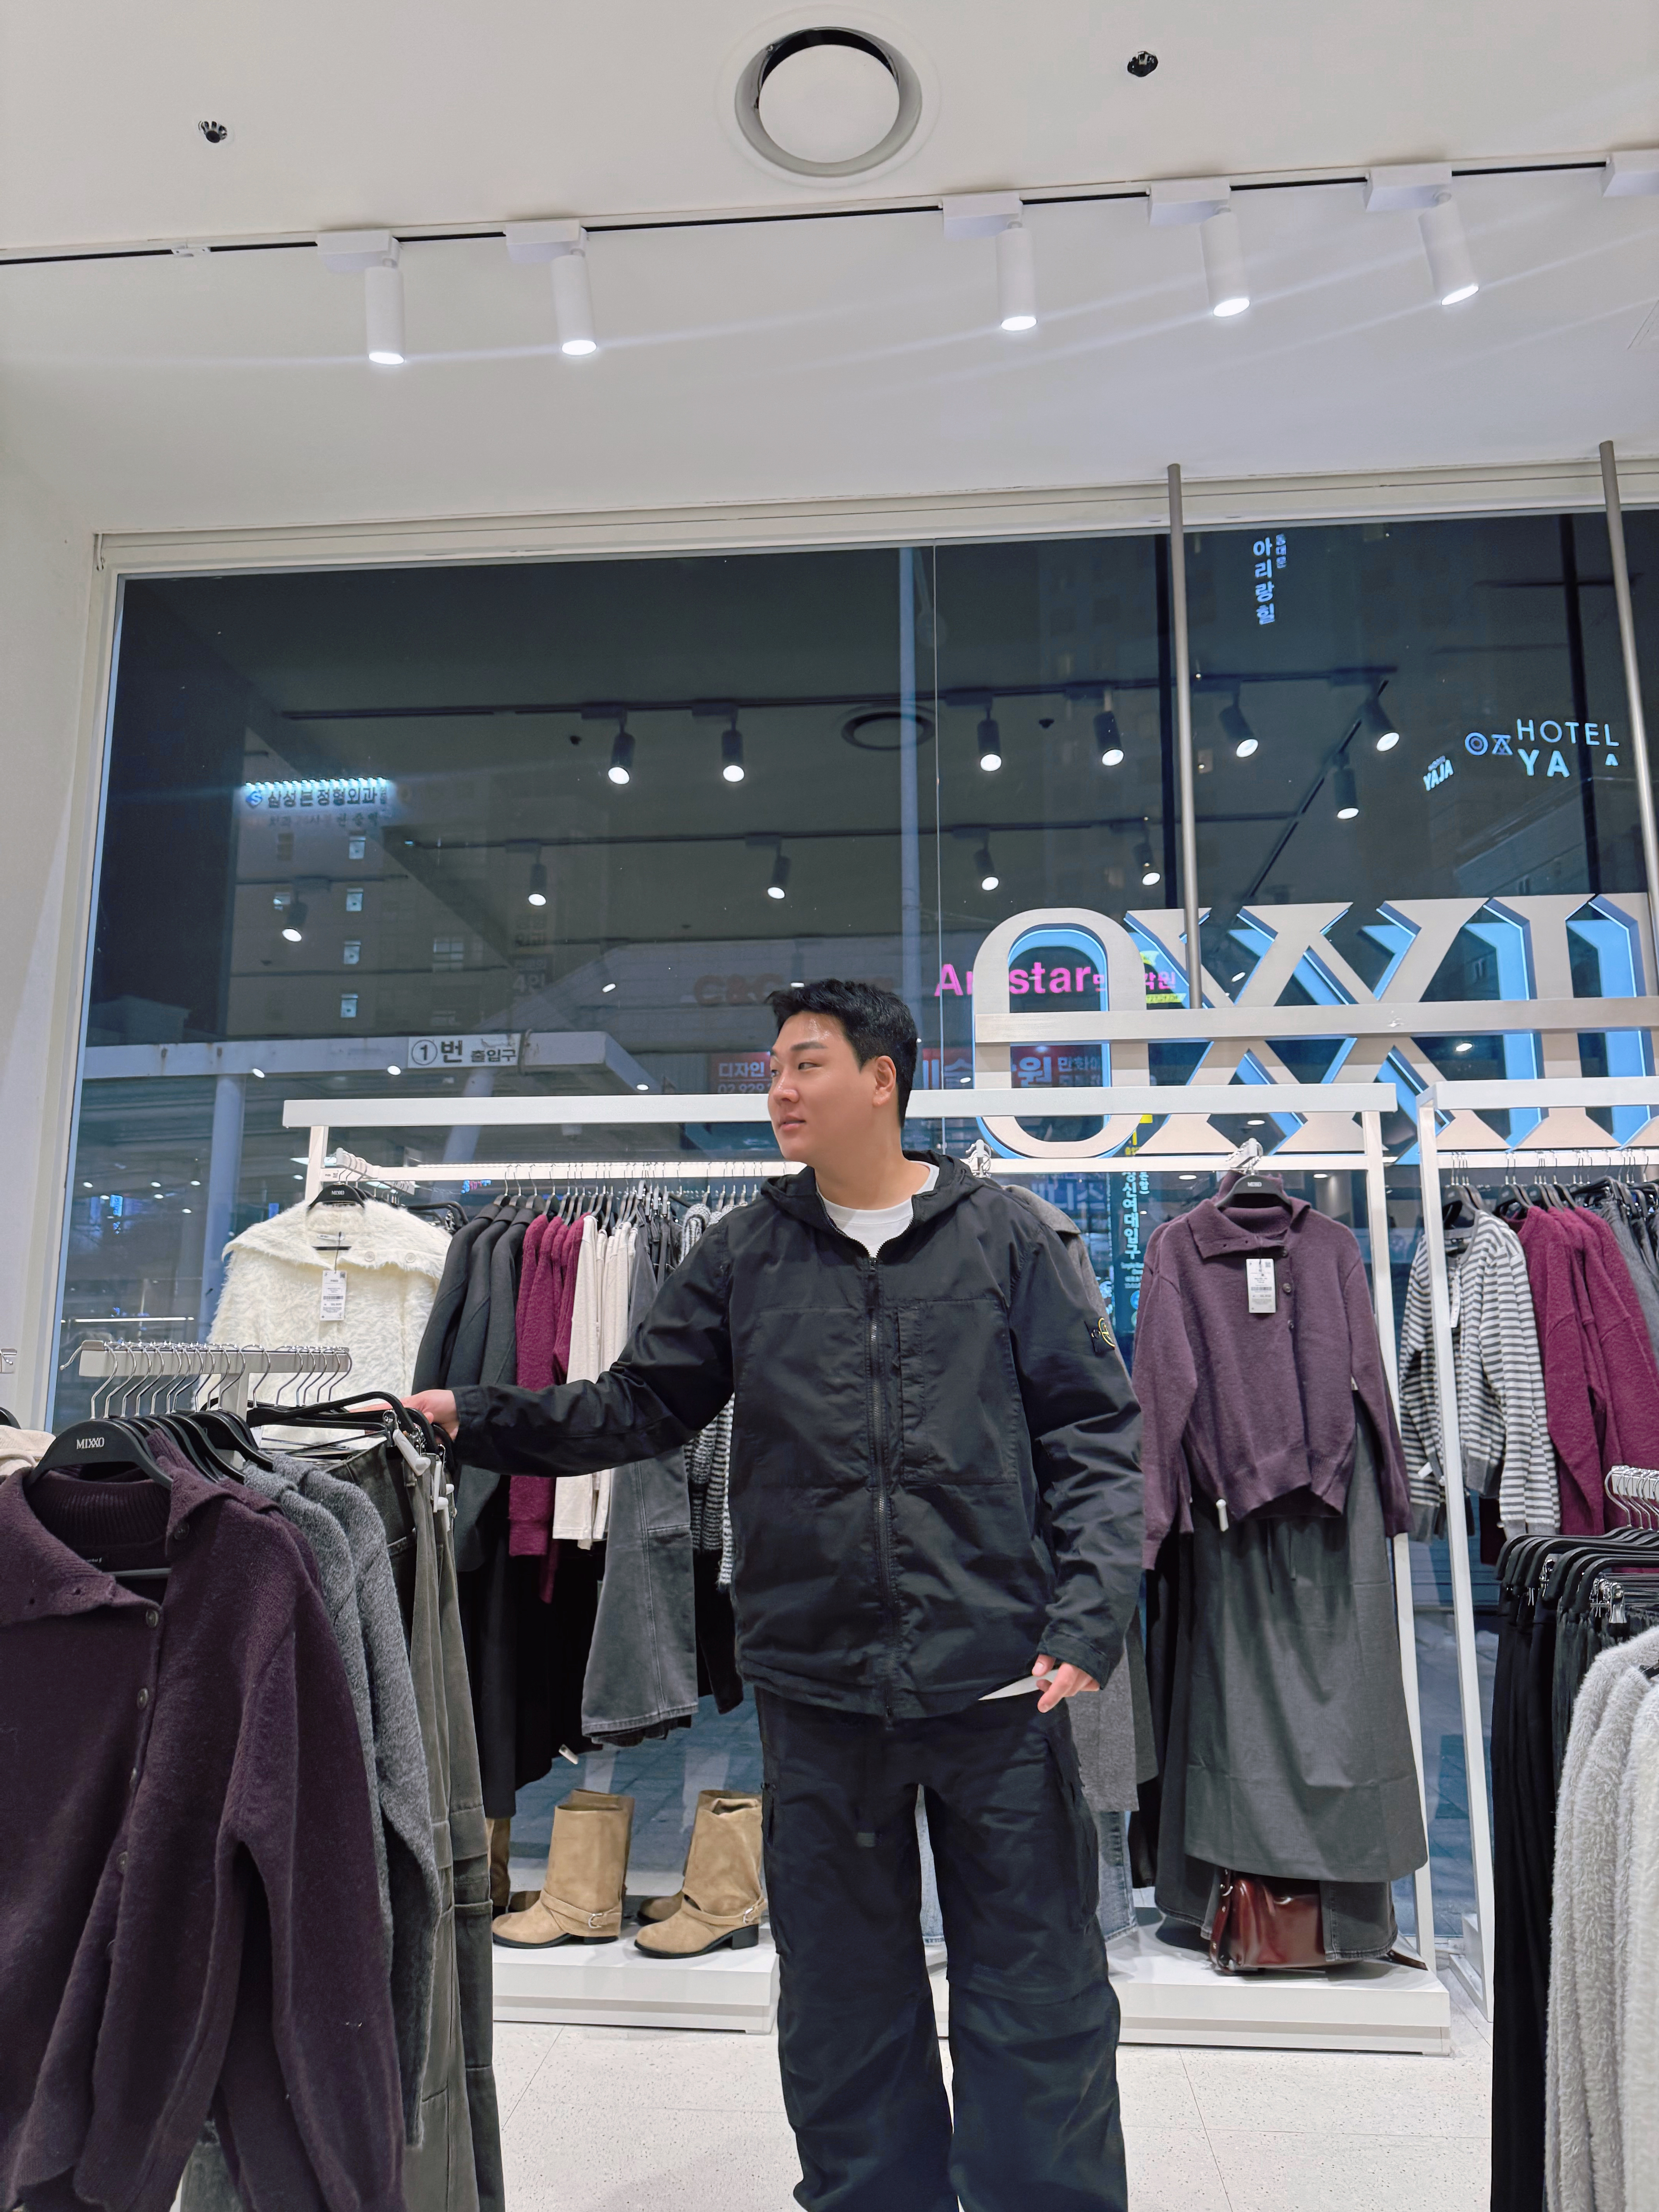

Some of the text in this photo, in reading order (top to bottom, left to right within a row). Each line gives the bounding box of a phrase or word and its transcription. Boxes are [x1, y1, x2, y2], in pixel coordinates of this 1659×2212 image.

[1517, 718, 1619, 746] HOTEL
[1423, 759, 1453, 791] YAJA
[1517, 749, 1618, 778] YAA
[441, 1040, 463, 1063] 번
[471, 1049, 517, 1063] 출입구
[719, 1061, 765, 1078] 디자인
[77, 1437, 105, 1449] MIXXO
